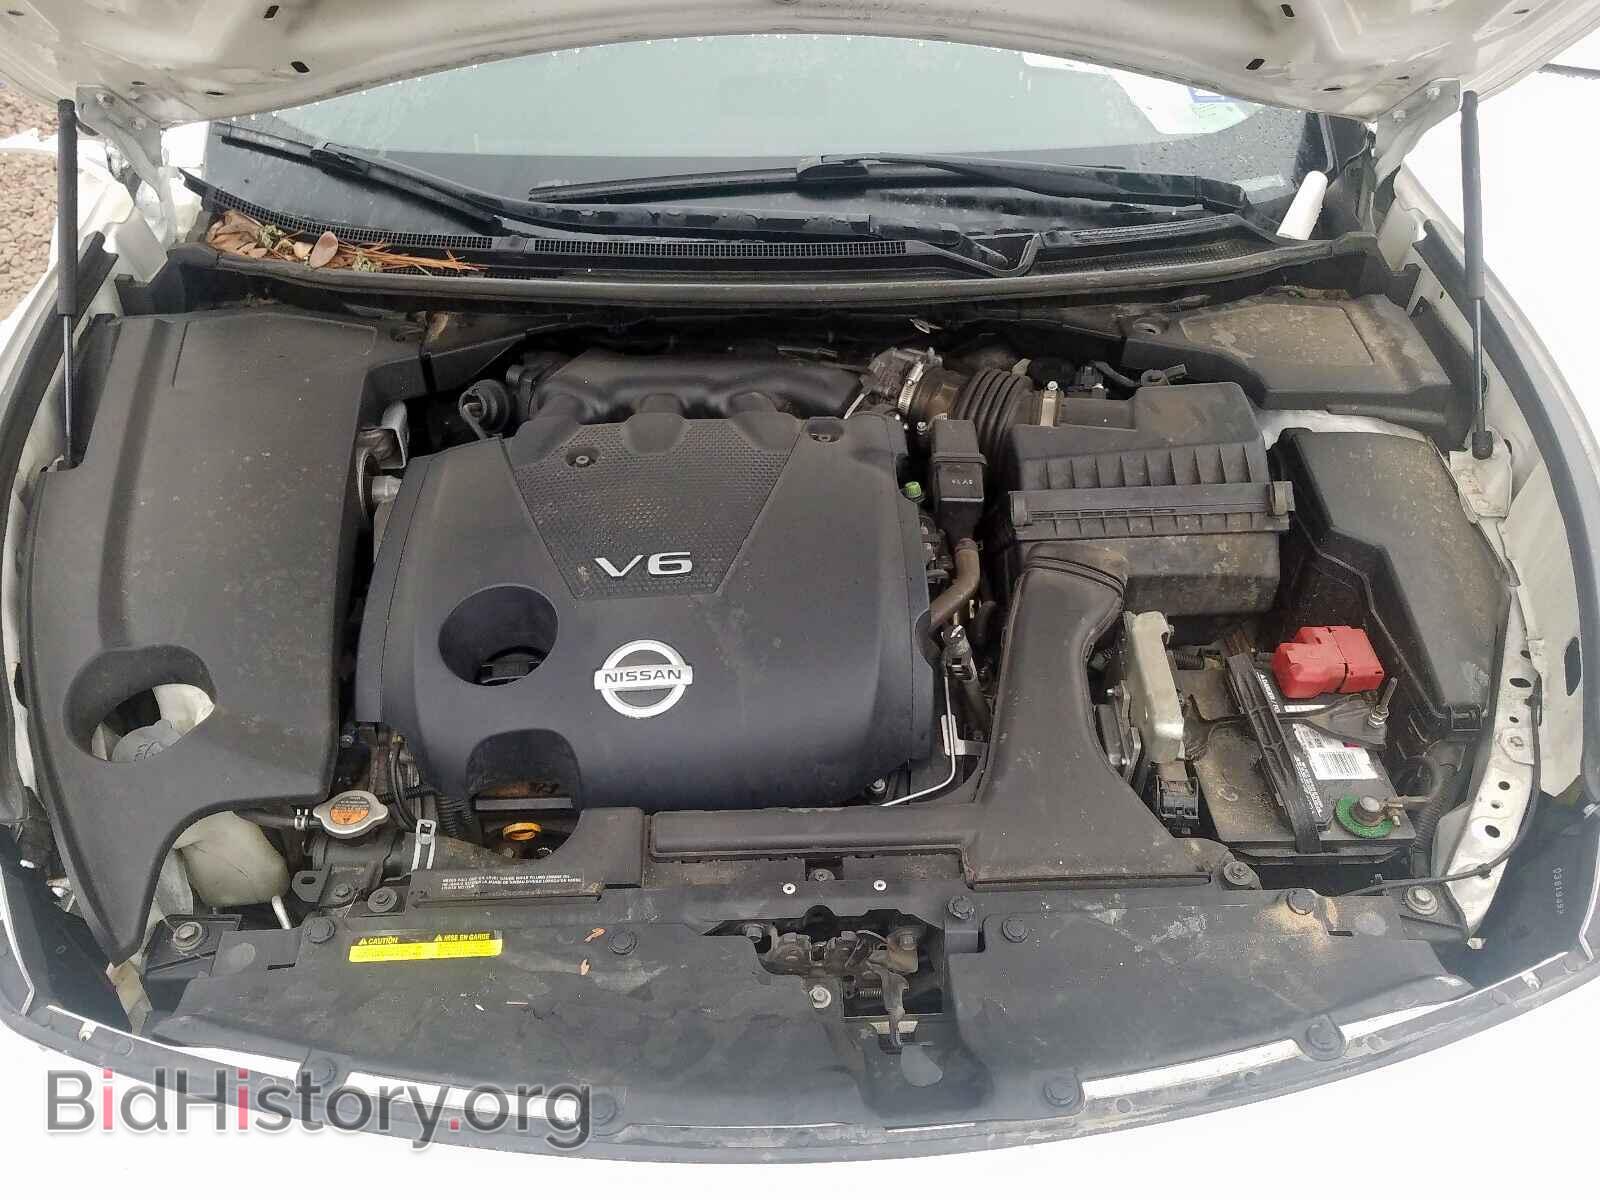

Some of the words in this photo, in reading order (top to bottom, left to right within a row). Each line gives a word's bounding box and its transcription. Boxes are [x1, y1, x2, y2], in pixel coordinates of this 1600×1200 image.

[594, 551, 693, 577] V6
[604, 669, 682, 684] NISSAN
[368, 936, 398, 945] CAUTION
[443, 934, 459, 942] MISE
[469, 933, 490, 941] GARDE
